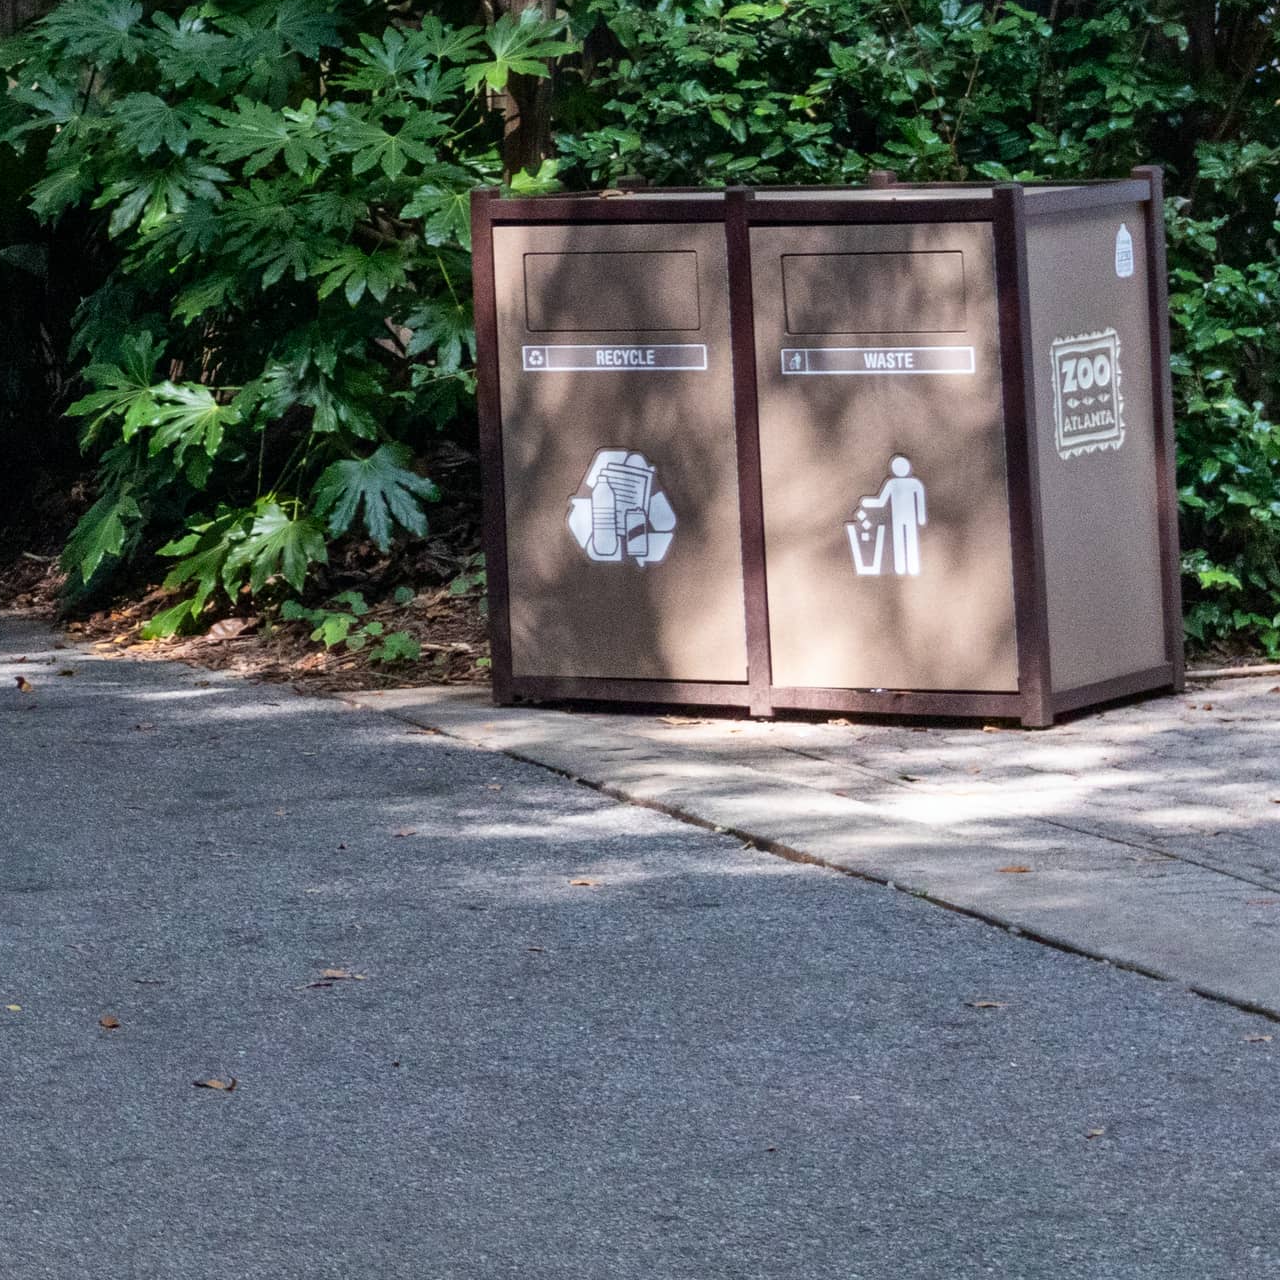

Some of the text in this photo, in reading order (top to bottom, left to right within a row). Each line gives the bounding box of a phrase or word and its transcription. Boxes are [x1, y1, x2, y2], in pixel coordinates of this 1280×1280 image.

[596, 350, 655, 365] RECYCLE
[863, 352, 914, 369] WASTE
[1062, 354, 1111, 392] ZOO
[1064, 409, 1115, 432] ATLANTA
